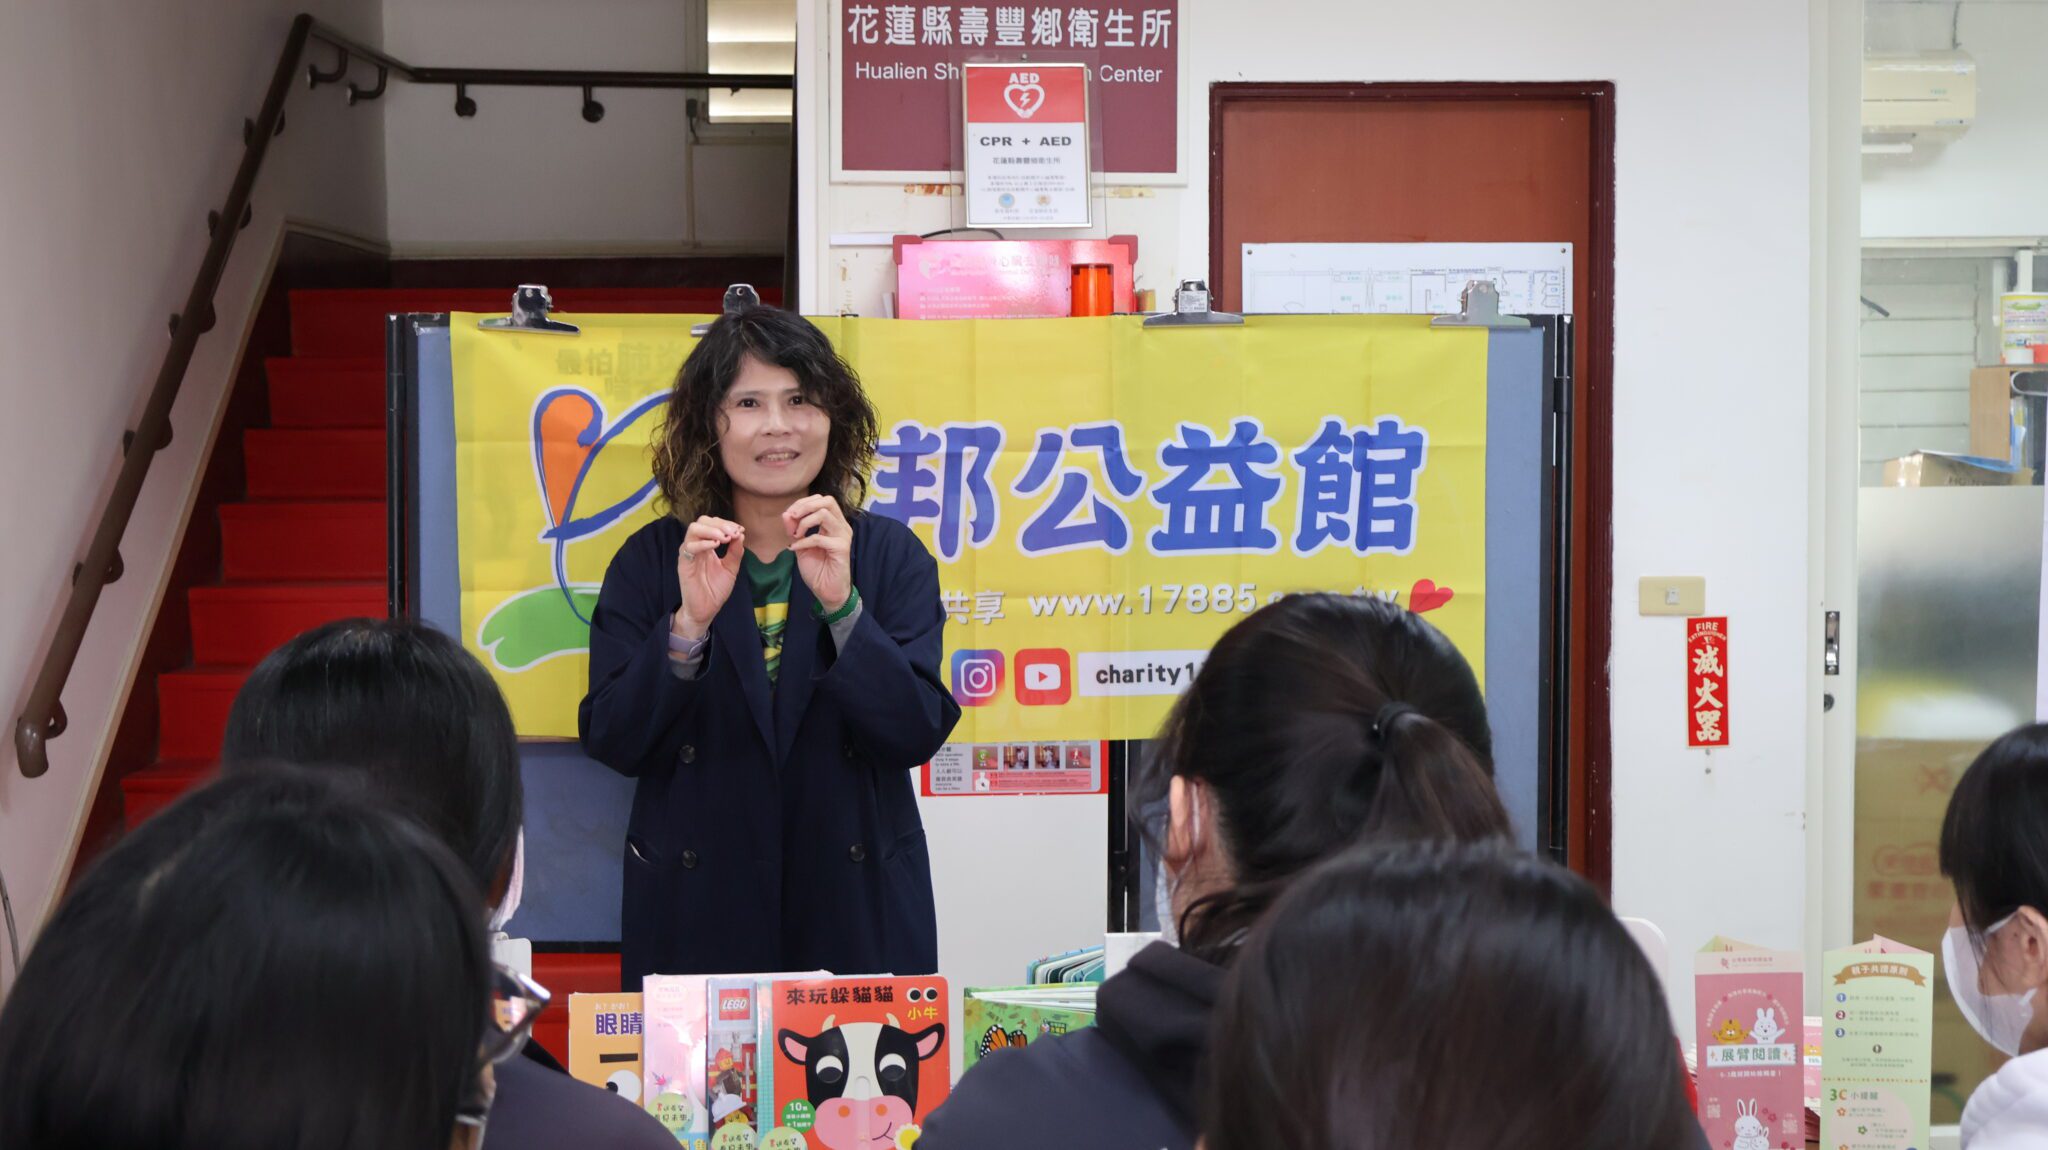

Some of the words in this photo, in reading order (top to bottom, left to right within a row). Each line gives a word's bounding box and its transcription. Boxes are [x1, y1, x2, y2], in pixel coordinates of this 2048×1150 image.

[848, 5, 1172, 49] 花蓮縣壽豐鄉衛生所
[856, 62, 927, 80] Hualien
[934, 62, 964, 81] Sh
[1009, 72, 1040, 84] AED
[1100, 65, 1163, 83] Center
[980, 136, 1012, 146] CPR
[1040, 136, 1072, 146] AED
[867, 418, 1428, 563] 邦公益館
[1696, 621, 1719, 632] FIRE
[1095, 661, 1206, 686] charity1
[1692, 644, 1724, 742] 滅火器
[722, 998, 748, 1010] LEGO
[786, 986, 894, 1006] 來玩躲貓貓
[907, 1006, 939, 1021] 小牛
[595, 1012, 643, 1035] 眼睛
[1721, 1047, 1781, 1062] 展臂閱讀
[1830, 1088, 1848, 1101] 3C
